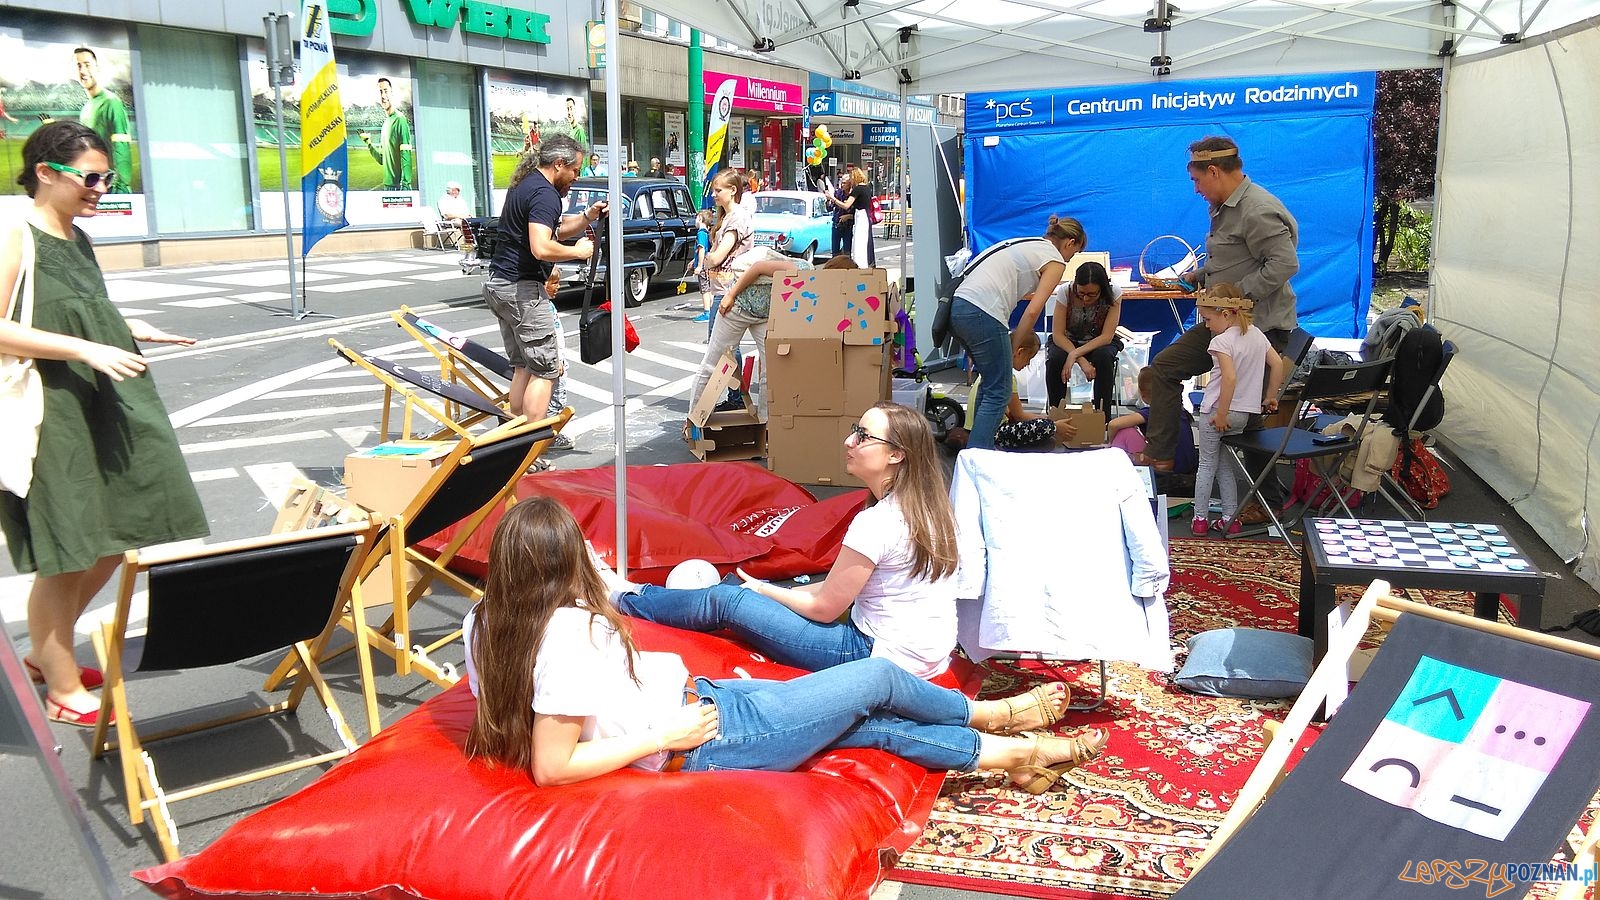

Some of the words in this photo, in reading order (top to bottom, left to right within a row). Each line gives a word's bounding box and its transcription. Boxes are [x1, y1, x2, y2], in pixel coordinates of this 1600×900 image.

[404, 0, 551, 44] WBK
[747, 77, 787, 101] Millennium
[1067, 97, 1143, 115] Centrum
[1151, 90, 1236, 111] Inicjatyw
[1245, 82, 1358, 104] Rodzinnych
[840, 95, 870, 116] CENTRUM
[871, 101, 900, 119] MEDYCZNE
